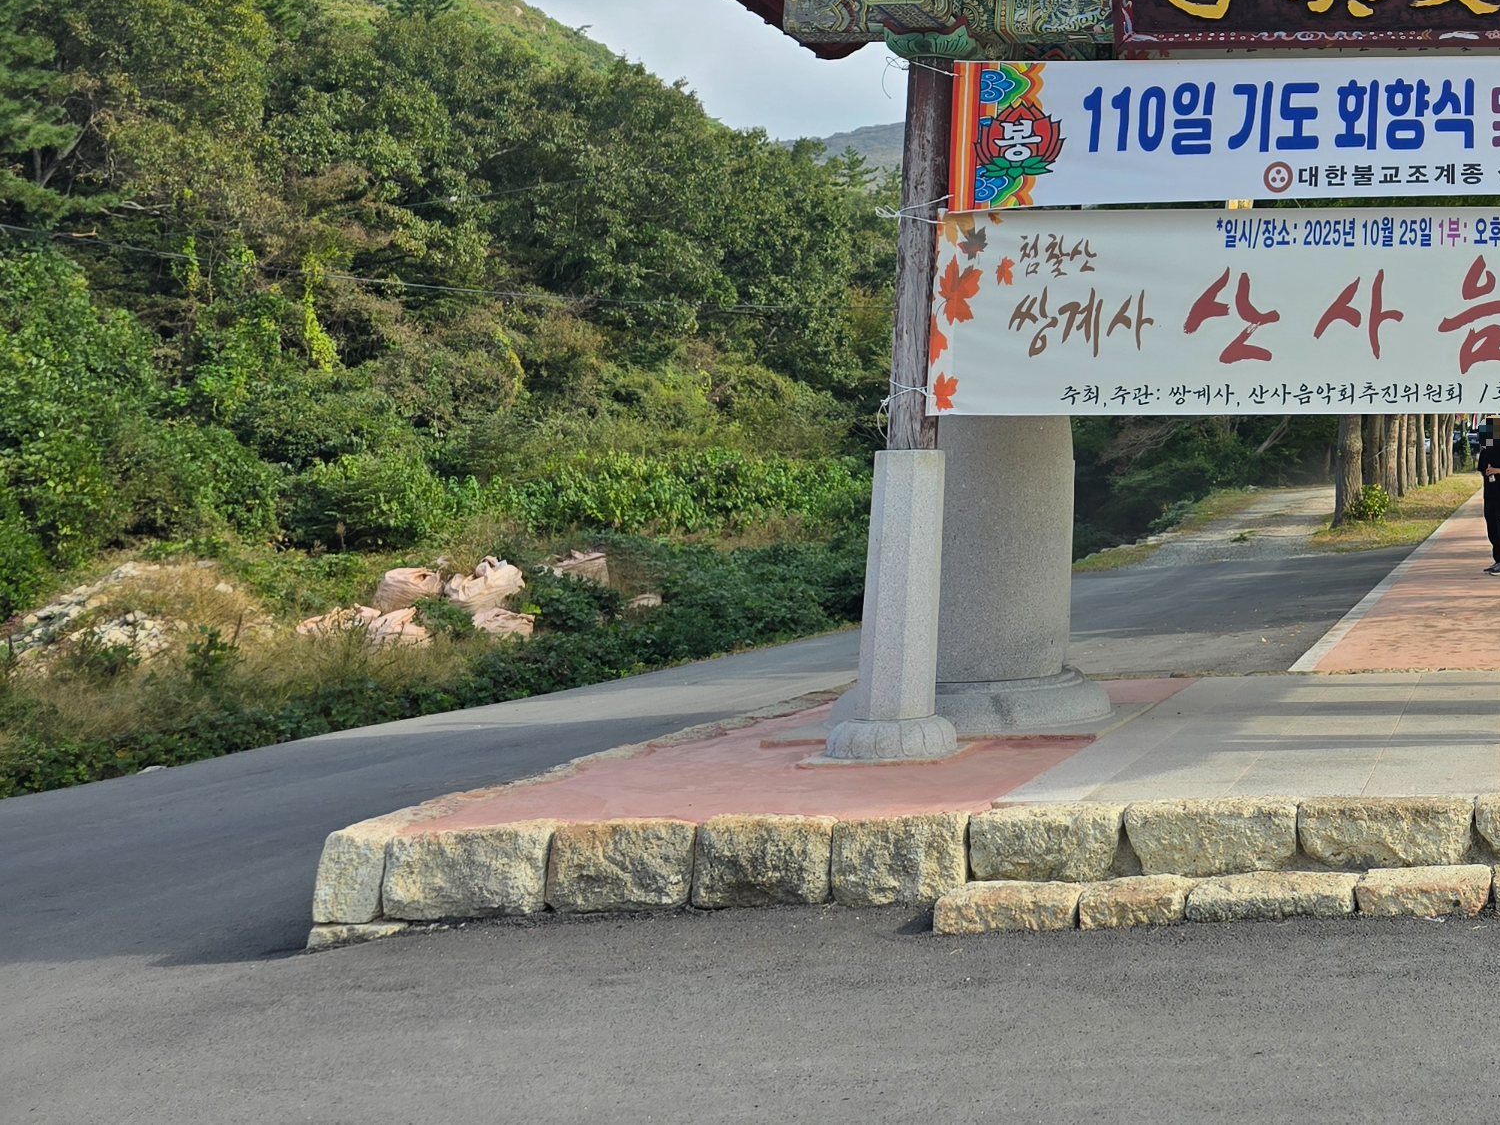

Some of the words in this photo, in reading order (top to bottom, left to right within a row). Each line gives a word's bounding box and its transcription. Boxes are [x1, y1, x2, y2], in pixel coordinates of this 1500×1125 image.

[1083, 80, 1216, 156] 110일
[1228, 79, 1320, 153] 기도
[1333, 78, 1475, 151] 회향식
[994, 119, 1045, 163] 봉
[1298, 163, 1484, 188] 대한불교조계종
[1303, 217, 1356, 248] 2025년
[1362, 216, 1394, 248] 10월
[1399, 216, 1432, 248] 25일
[1438, 217, 1468, 248] 1부:
[1020, 233, 1097, 278] 첨찰산
[1008, 285, 1154, 358] 쌍계사
[1168, 383, 1240, 407] 쌍계사,
[1249, 382, 1463, 406] 산사음악회추진위원회
